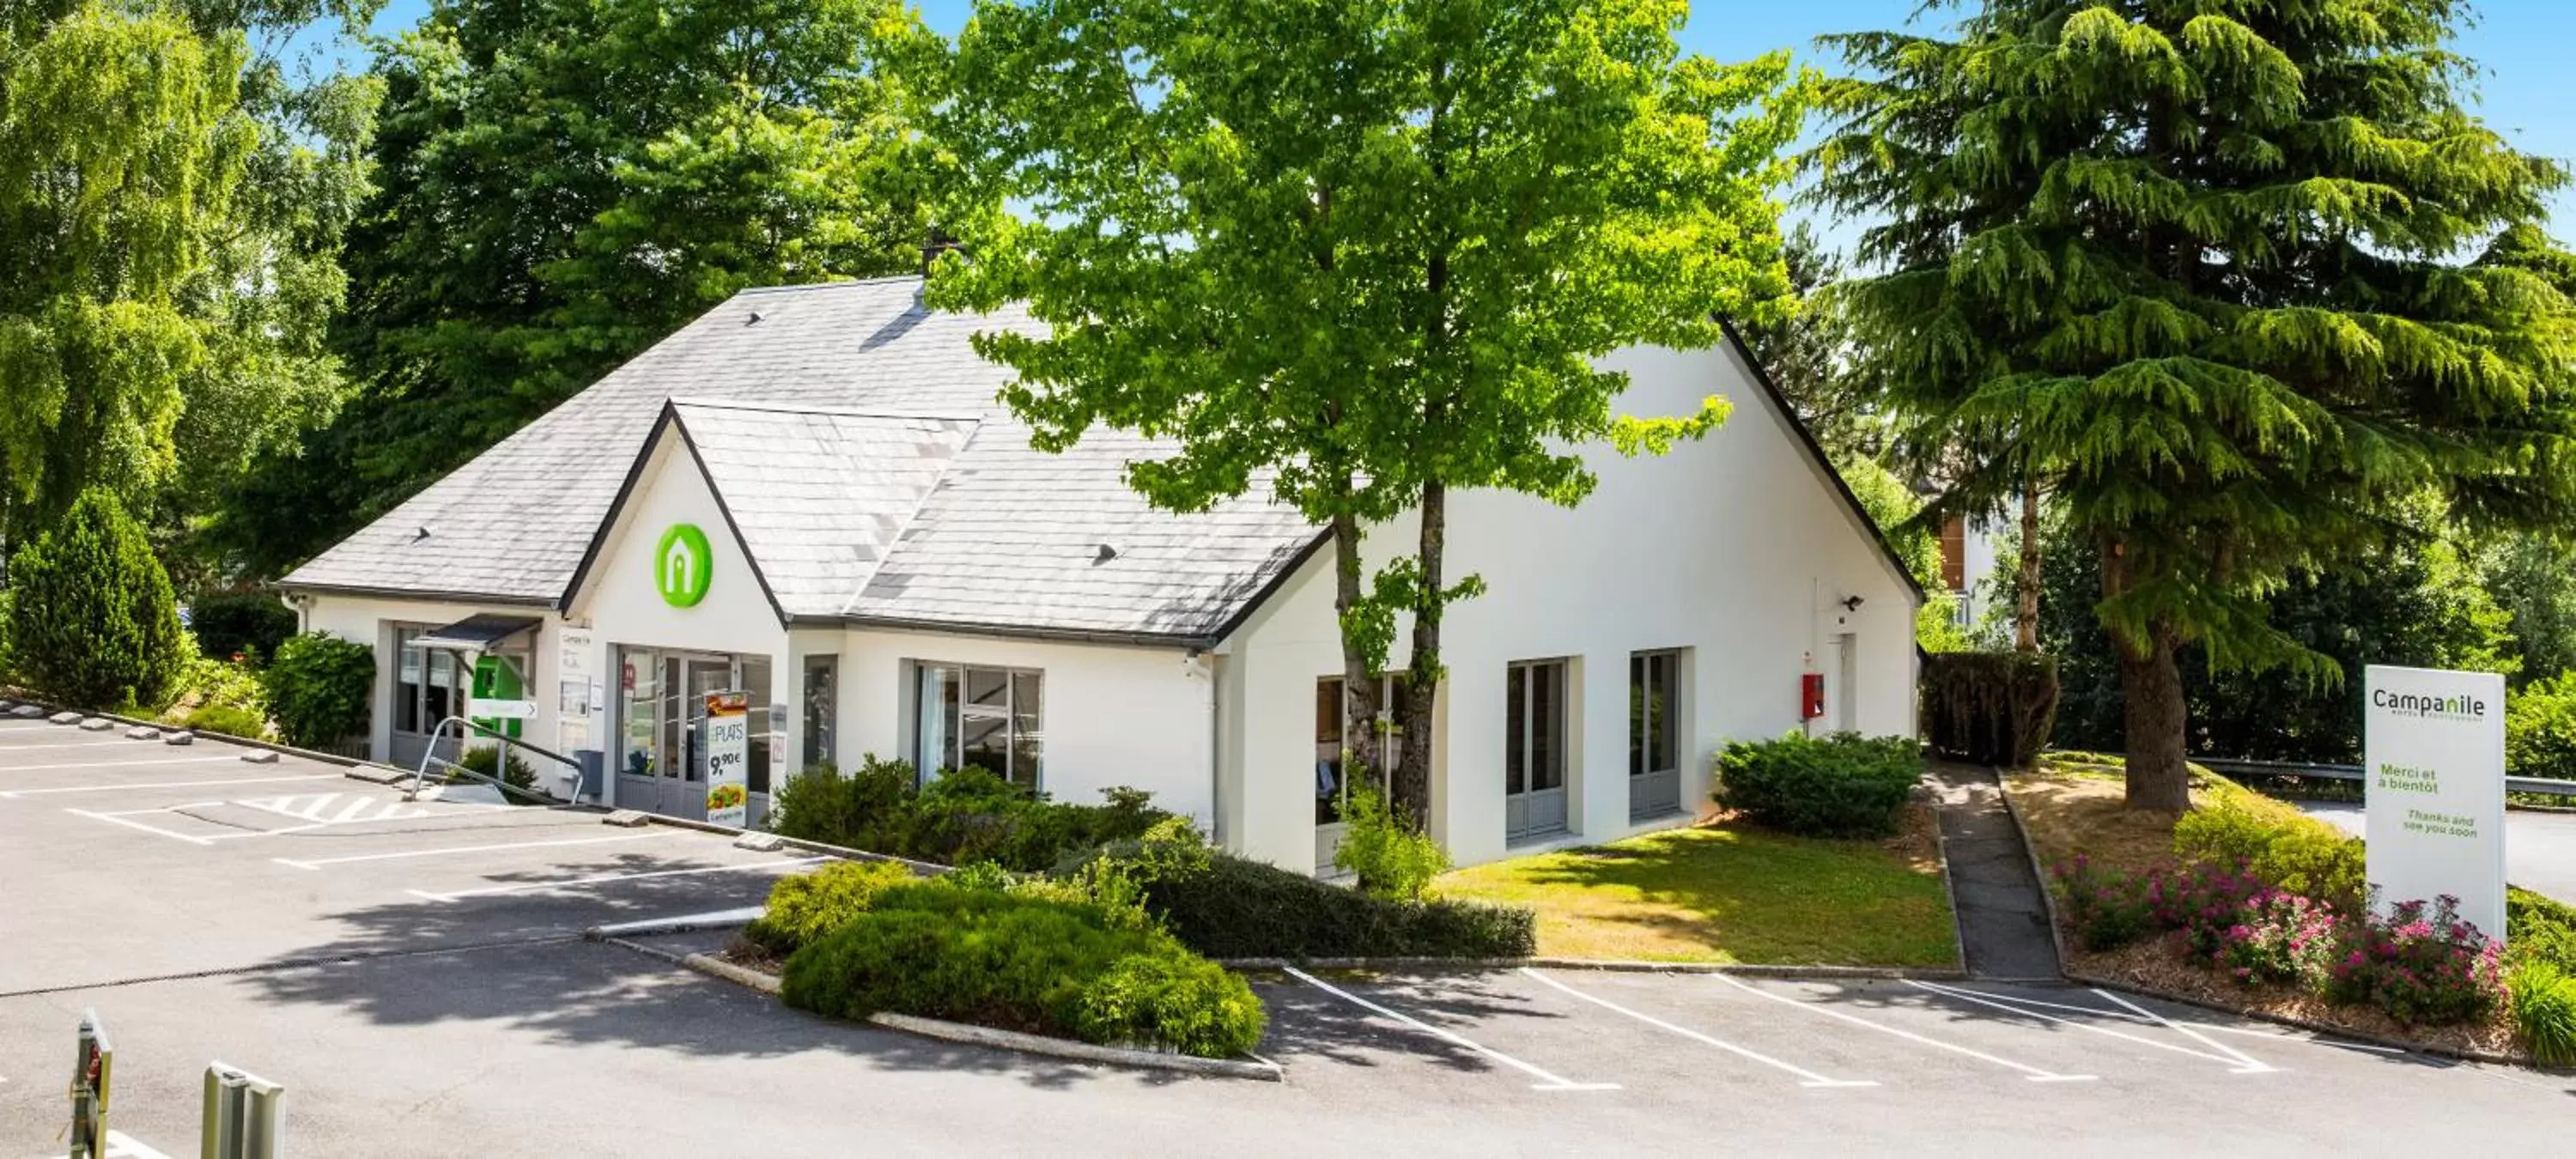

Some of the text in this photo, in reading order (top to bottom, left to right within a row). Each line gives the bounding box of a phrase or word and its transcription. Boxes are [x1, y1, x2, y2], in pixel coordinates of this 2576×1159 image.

[2373, 689, 2485, 718] Campanile
[2380, 763, 2436, 781] Merci et
[2408, 809, 2475, 828] Thanks and
[2403, 820, 2478, 839] see you soon
